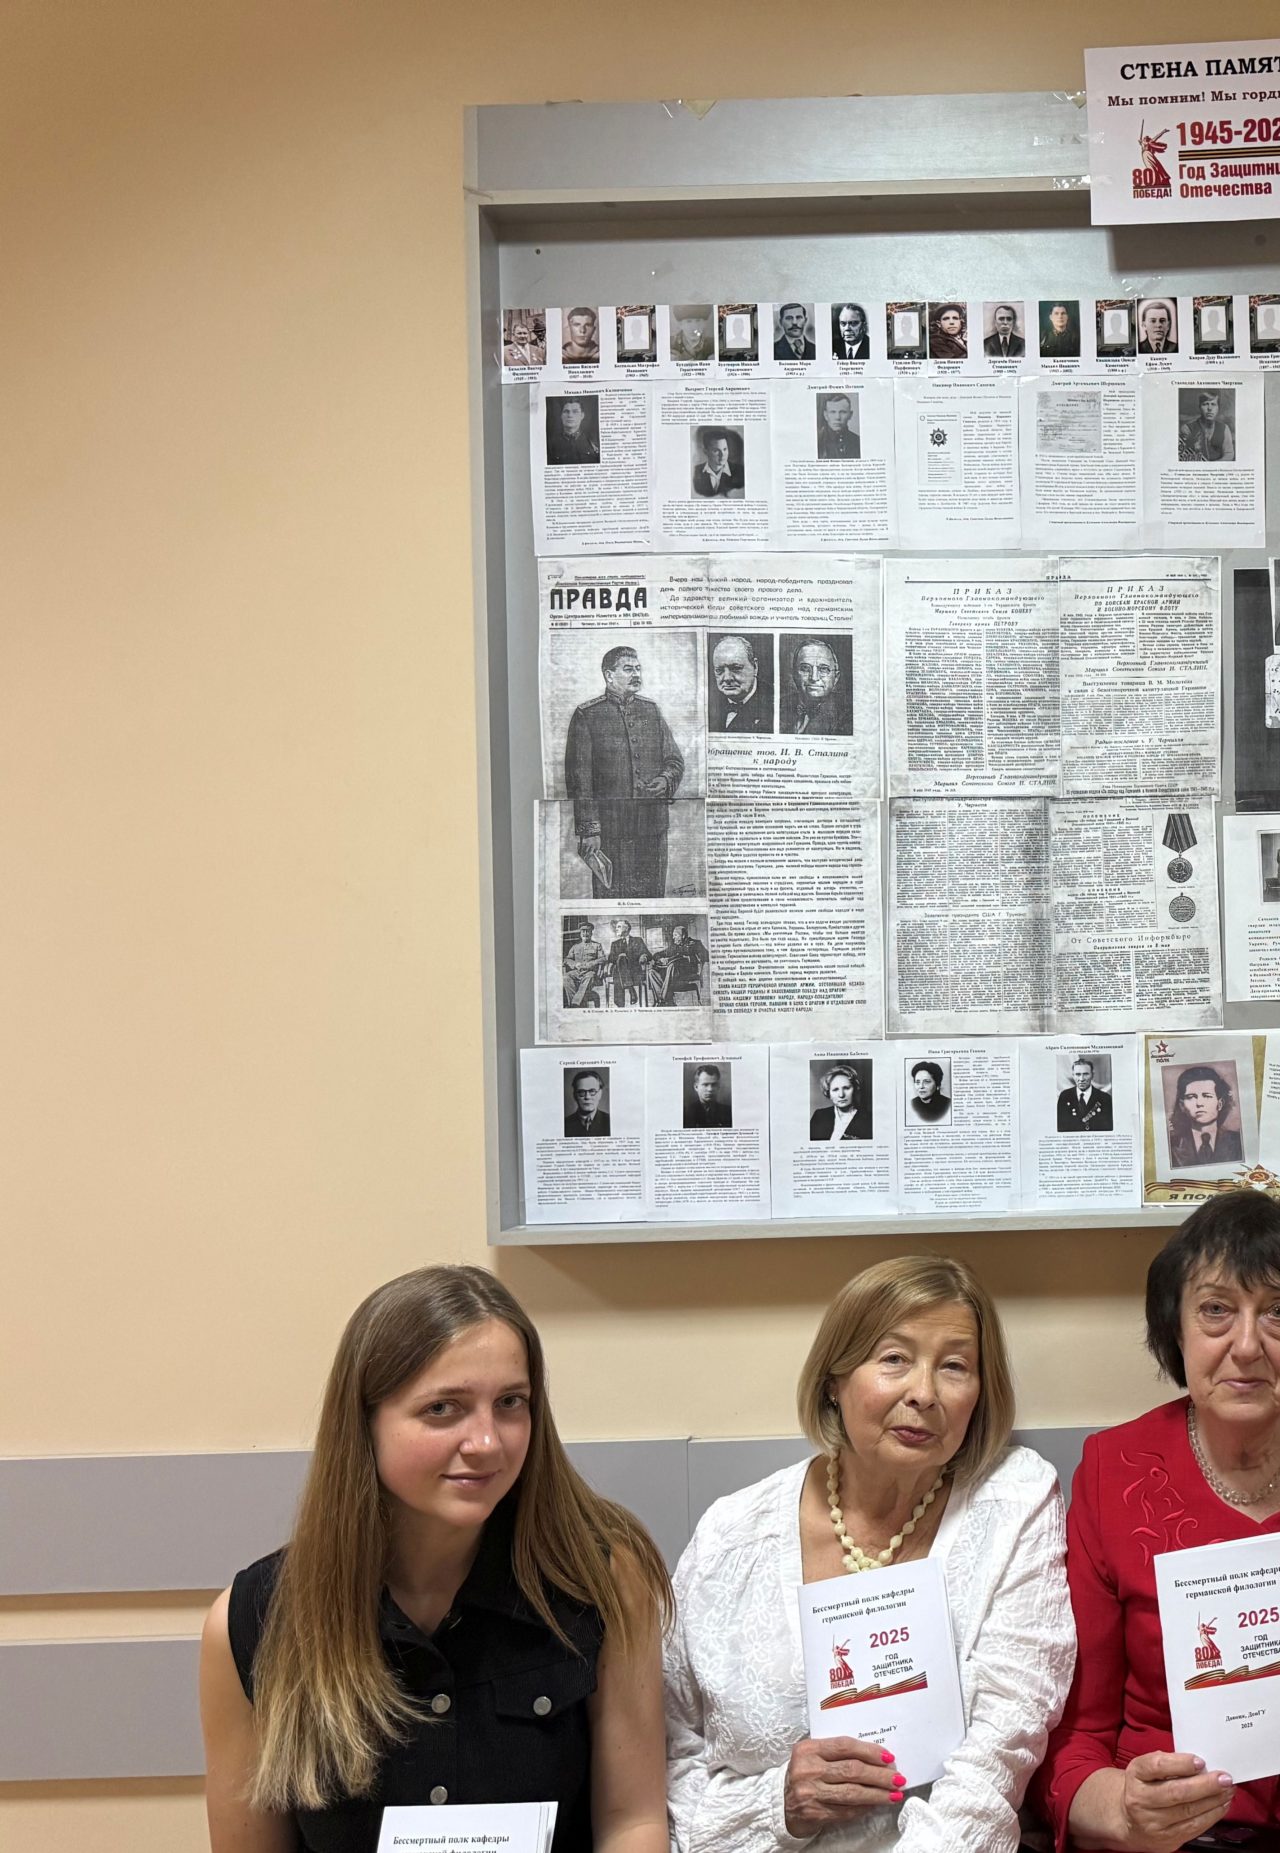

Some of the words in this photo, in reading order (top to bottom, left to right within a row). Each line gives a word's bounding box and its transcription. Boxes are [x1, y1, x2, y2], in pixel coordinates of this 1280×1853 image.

[1121, 61, 1198, 79] СТЕНА
[1108, 96, 1133, 106] Мы
[1139, 91, 1205, 105] помним!
[1211, 91, 1236, 102] Мы
[1133, 168, 1154, 186] 80
[1179, 162, 1205, 180] Год
[1133, 188, 1172, 199] ПОБЕДА!
[1180, 182, 1272, 198] Отечества
[550, 587, 647, 611] ПРАВДА
[808, 749, 848, 757] Сталина
[1174, 1574, 1227, 1587] Бессмертный
[1229, 1572, 1249, 1580] полк
[1186, 1585, 1231, 1599] германской
[1233, 1579, 1277, 1594] филологии
[812, 1598, 860, 1614] Бессмертный
[862, 1594, 879, 1603] полк
[882, 1587, 915, 1600] кафедры
[822, 1609, 863, 1624] германской
[865, 1600, 906, 1616] филологии
[1238, 1607, 1280, 1628] 2025
[869, 1627, 909, 1648] 2025
[1255, 1634, 1268, 1642] ГОД
[885, 1653, 898, 1661] ГОД
[1195, 1647, 1209, 1660] 80
[872, 1658, 913, 1671] ЗАЩИТНИКА
[874, 1665, 913, 1678] ОТЕЧЕСТВА
[1196, 1660, 1222, 1669] ПОБЕДА!
[829, 1667, 843, 1680] 80
[831, 1679, 855, 1689] ПОБЕДА!
[393, 1836, 446, 1845] Бессмертный
[449, 1836, 469, 1844] полк
[472, 1835, 509, 1843] кафедры
